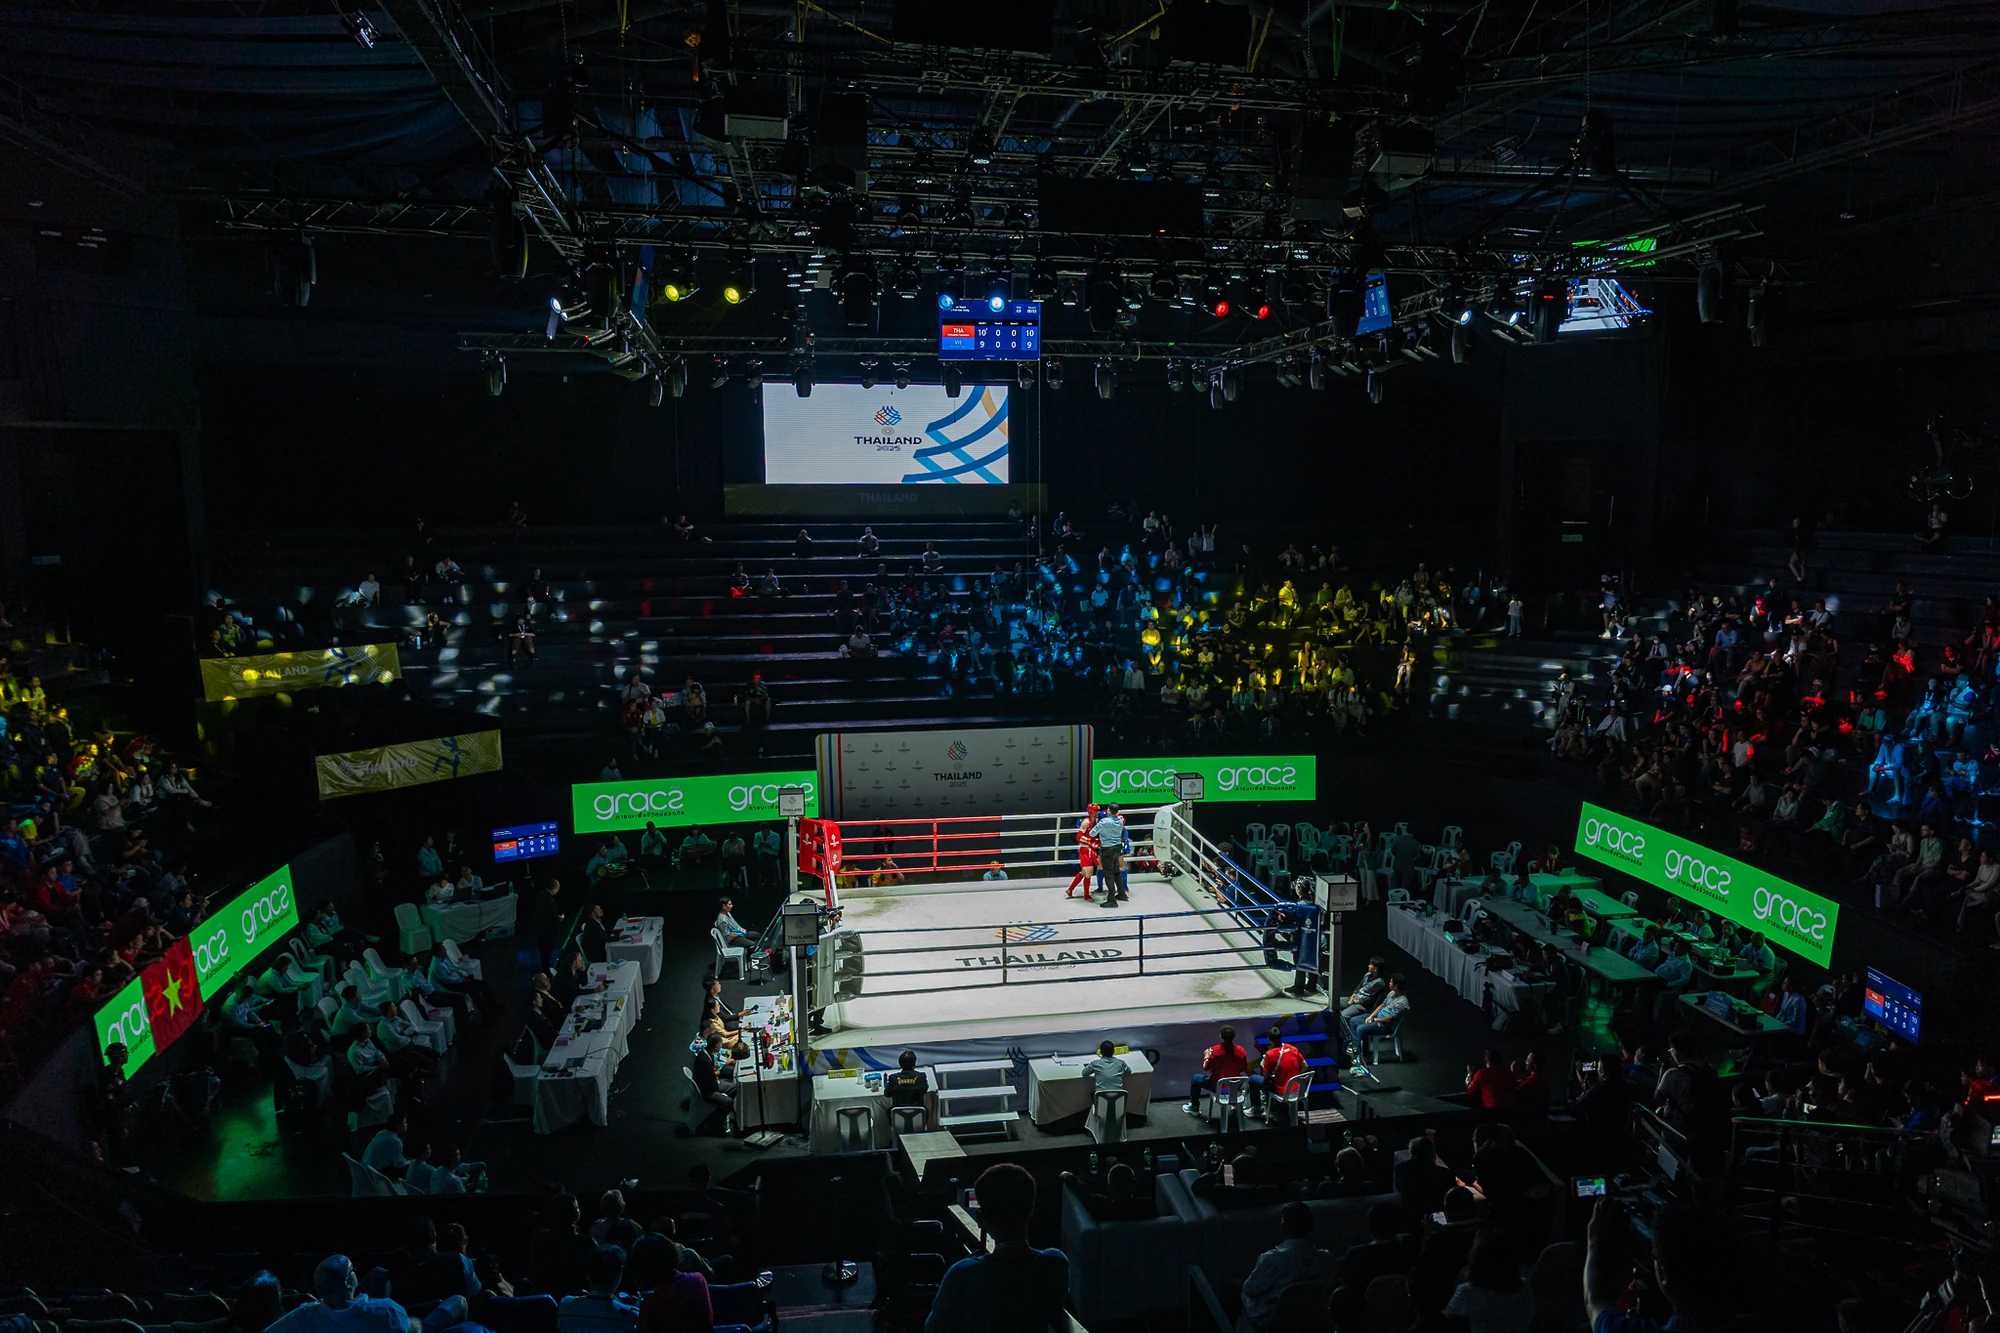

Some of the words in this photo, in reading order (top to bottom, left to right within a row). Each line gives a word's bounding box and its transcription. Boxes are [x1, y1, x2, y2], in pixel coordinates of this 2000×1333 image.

[854, 436, 922, 444] THAILAND
[858, 492, 918, 503] THAILAND
[933, 771, 983, 781] THAILAND
[955, 948, 1123, 967] THAILAND
